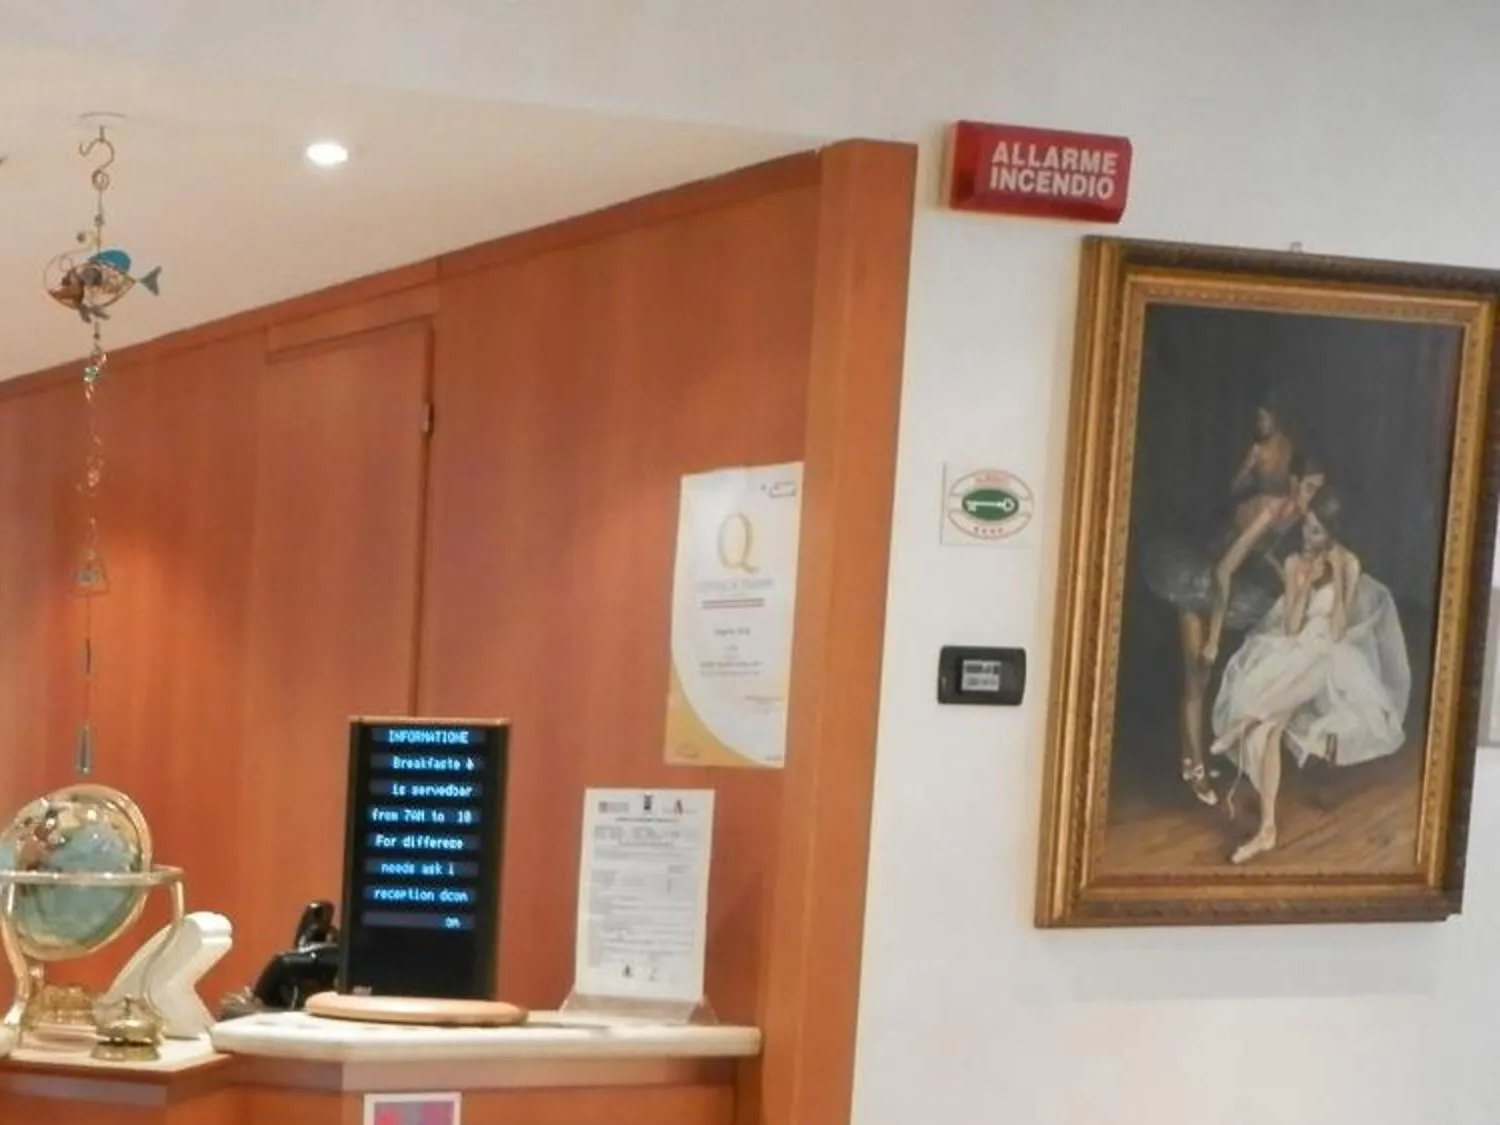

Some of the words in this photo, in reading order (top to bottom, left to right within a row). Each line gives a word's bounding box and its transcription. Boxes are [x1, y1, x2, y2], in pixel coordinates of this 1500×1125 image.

[991, 141, 1118, 174] ALLARME
[989, 165, 1114, 200] INCENDIO
[717, 511, 759, 574] Q
[372, 807, 399, 821] from
[431, 810, 445, 823] to
[375, 833, 396, 847] For
